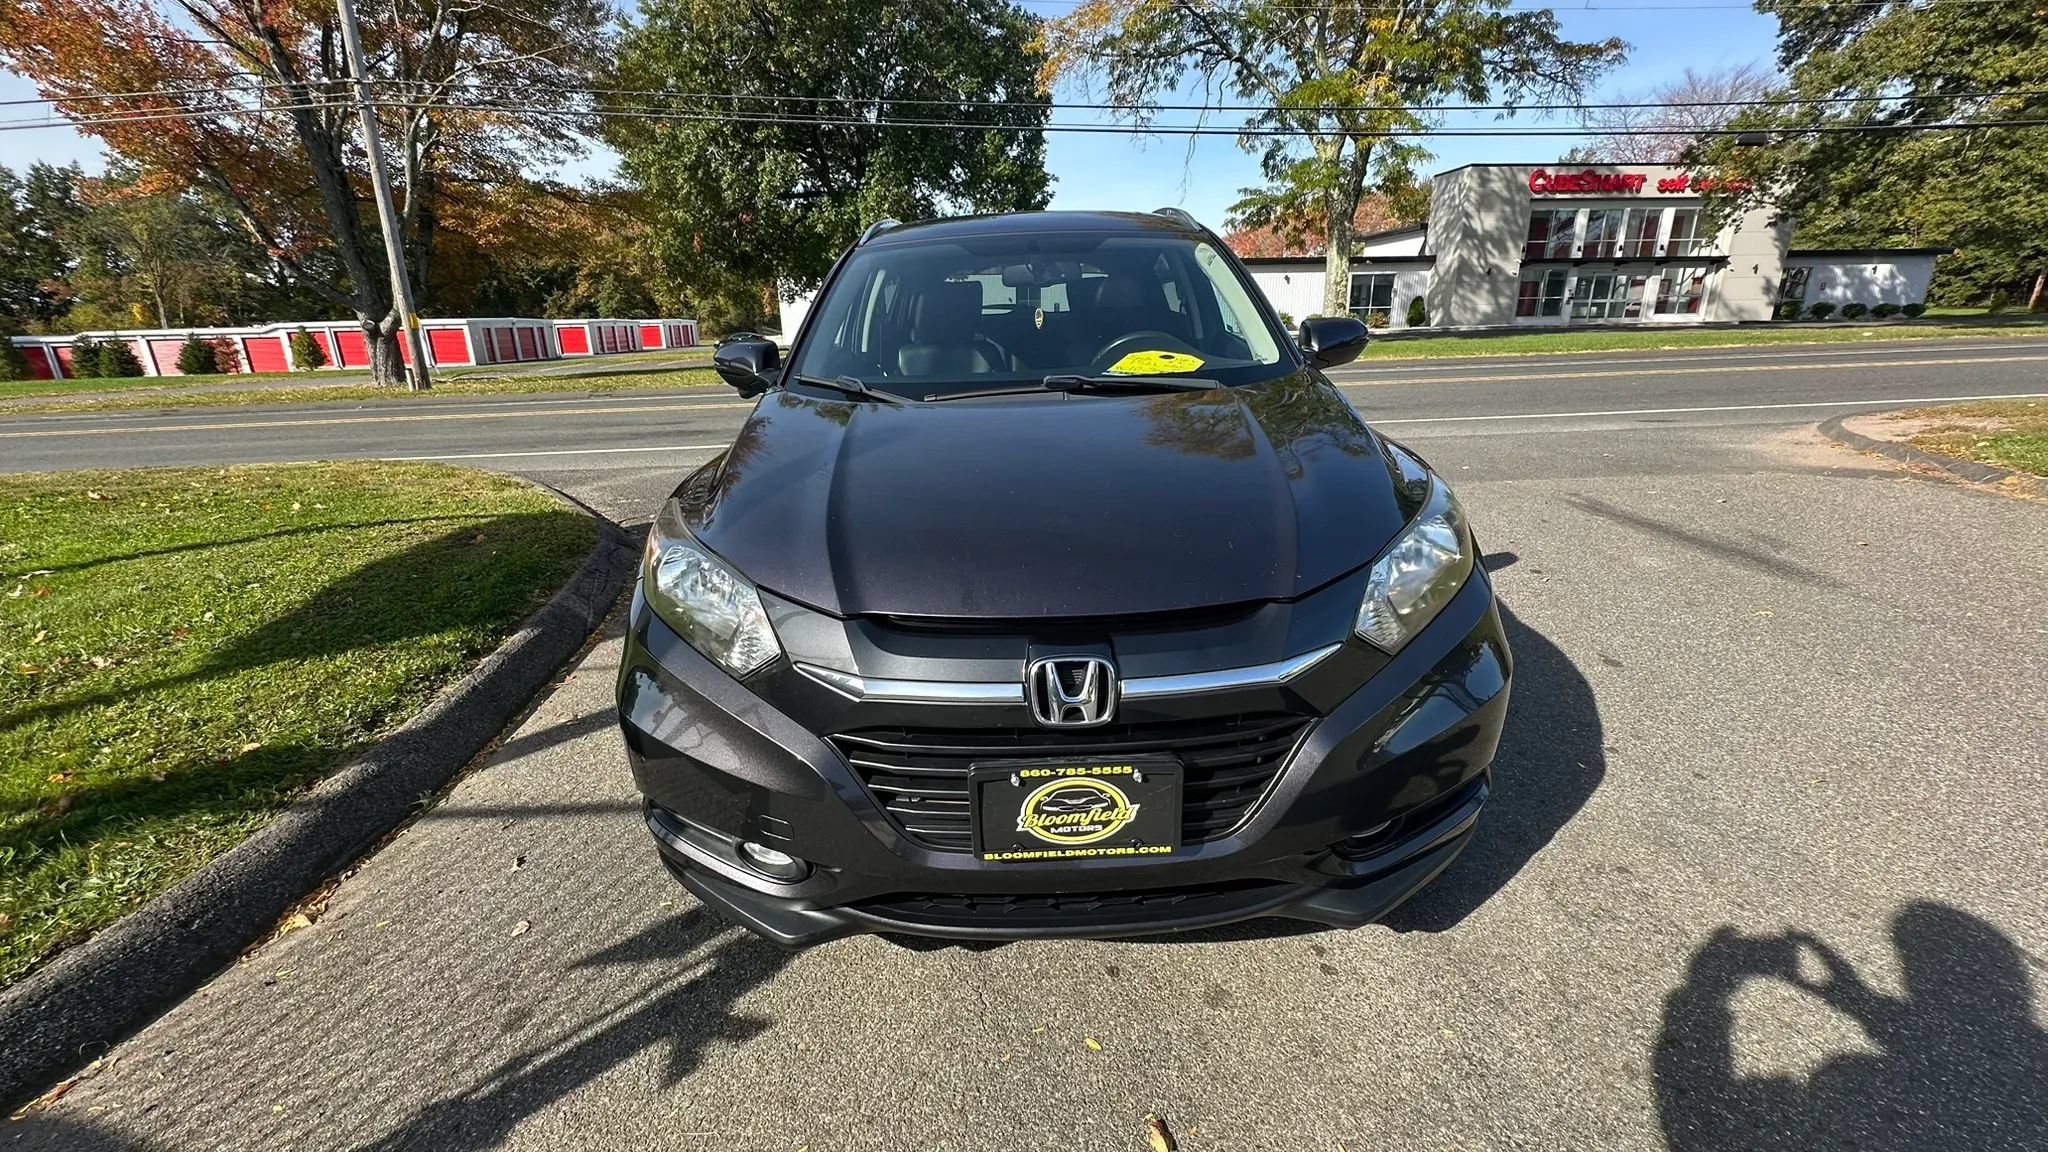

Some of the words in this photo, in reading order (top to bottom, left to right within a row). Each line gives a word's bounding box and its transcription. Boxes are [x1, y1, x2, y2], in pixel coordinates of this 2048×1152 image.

[1019, 766, 1133, 778] 860-785-5555
[1022, 806, 1135, 828] Bloomfield
[1050, 824, 1103, 834] MOTORS
[983, 845, 1172, 861] BLOOMFIELDMOTORS.COM
